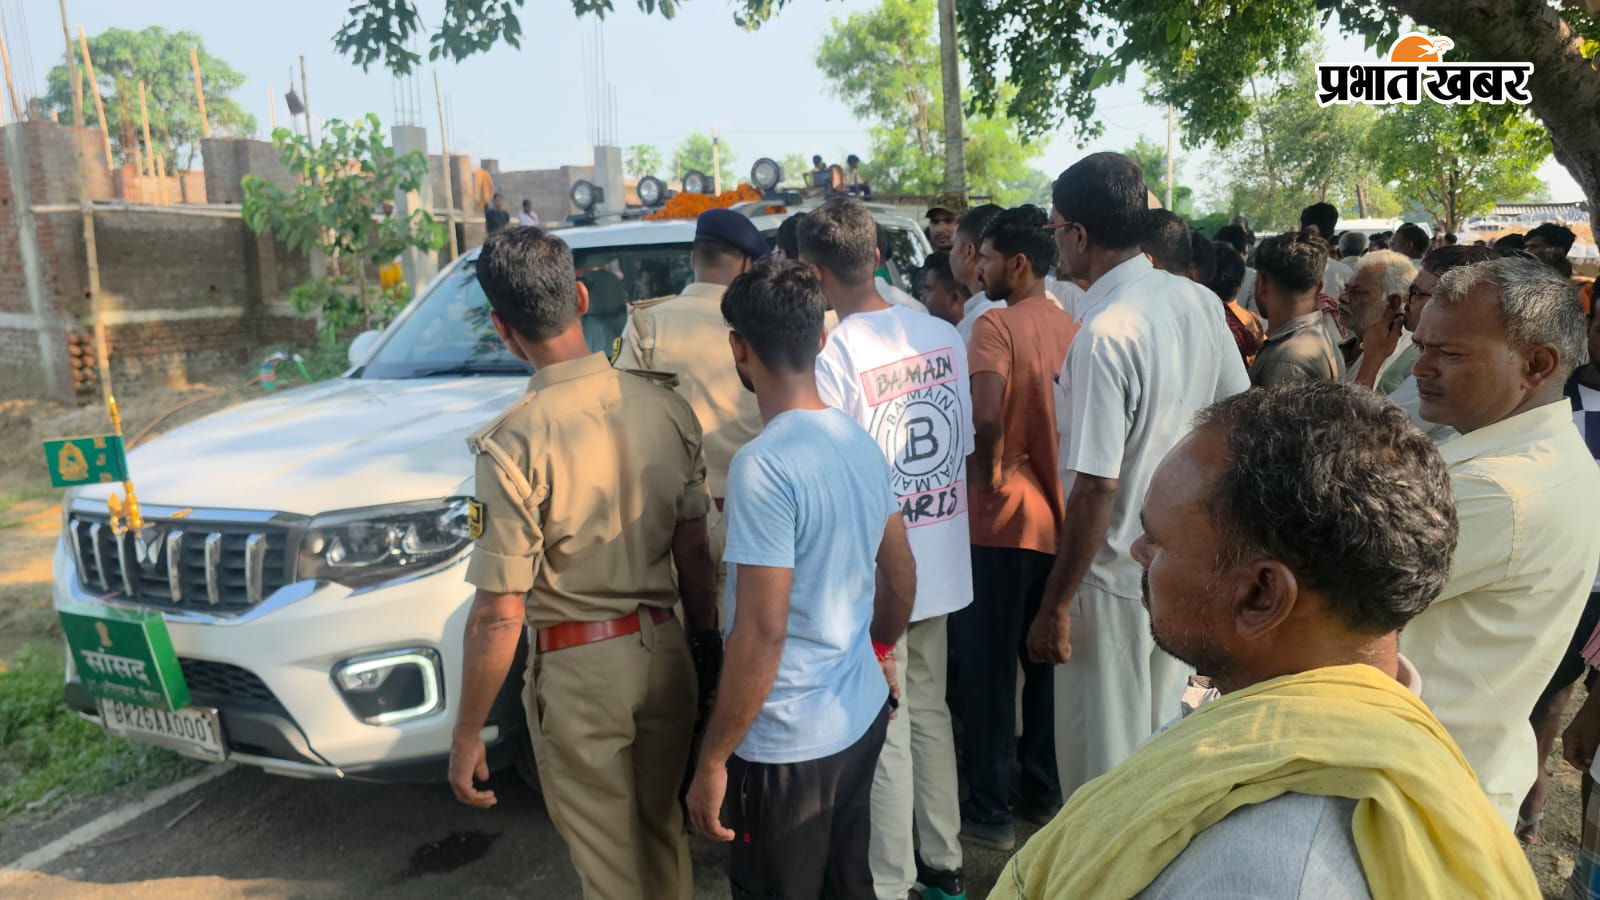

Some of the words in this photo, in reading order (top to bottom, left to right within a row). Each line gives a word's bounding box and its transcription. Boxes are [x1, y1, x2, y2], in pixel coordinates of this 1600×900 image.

[876, 354, 953, 398] BALMAIN
[886, 388, 954, 426] BALMAIN
[903, 416, 939, 465] B
[898, 486, 958, 523] ARIS
[79, 647, 151, 686] सांसद
